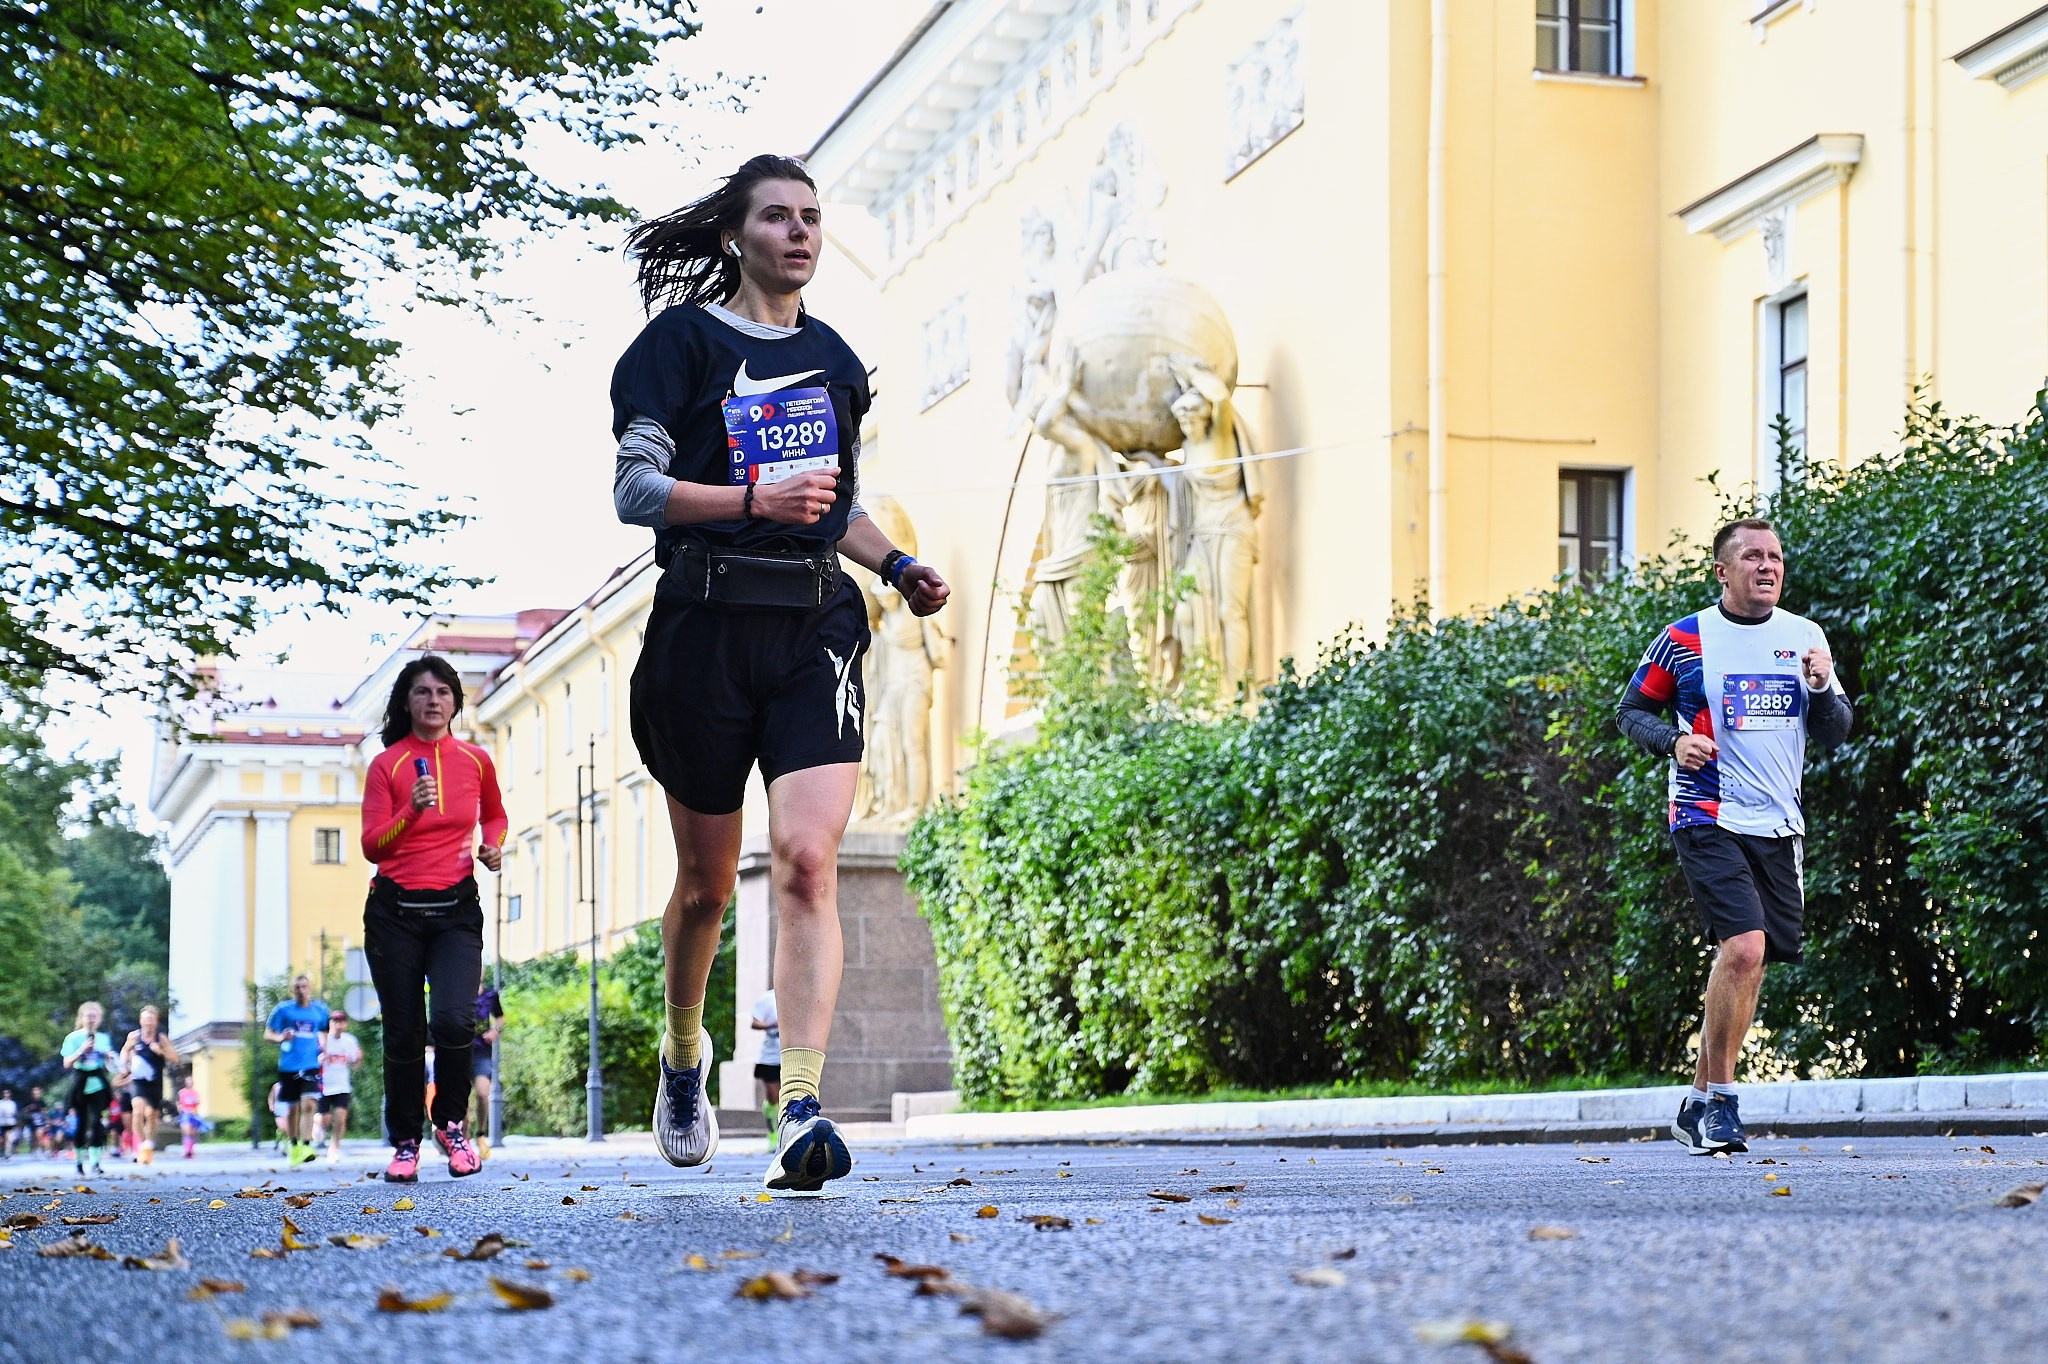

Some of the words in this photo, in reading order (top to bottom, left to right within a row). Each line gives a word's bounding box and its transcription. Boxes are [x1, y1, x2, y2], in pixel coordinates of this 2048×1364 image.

[757, 420, 827, 451] 13289
[733, 451, 745, 463] D
[781, 448, 807, 458] ИННА
[1742, 694, 1793, 710] 12889
[1726, 706, 1735, 715] C
